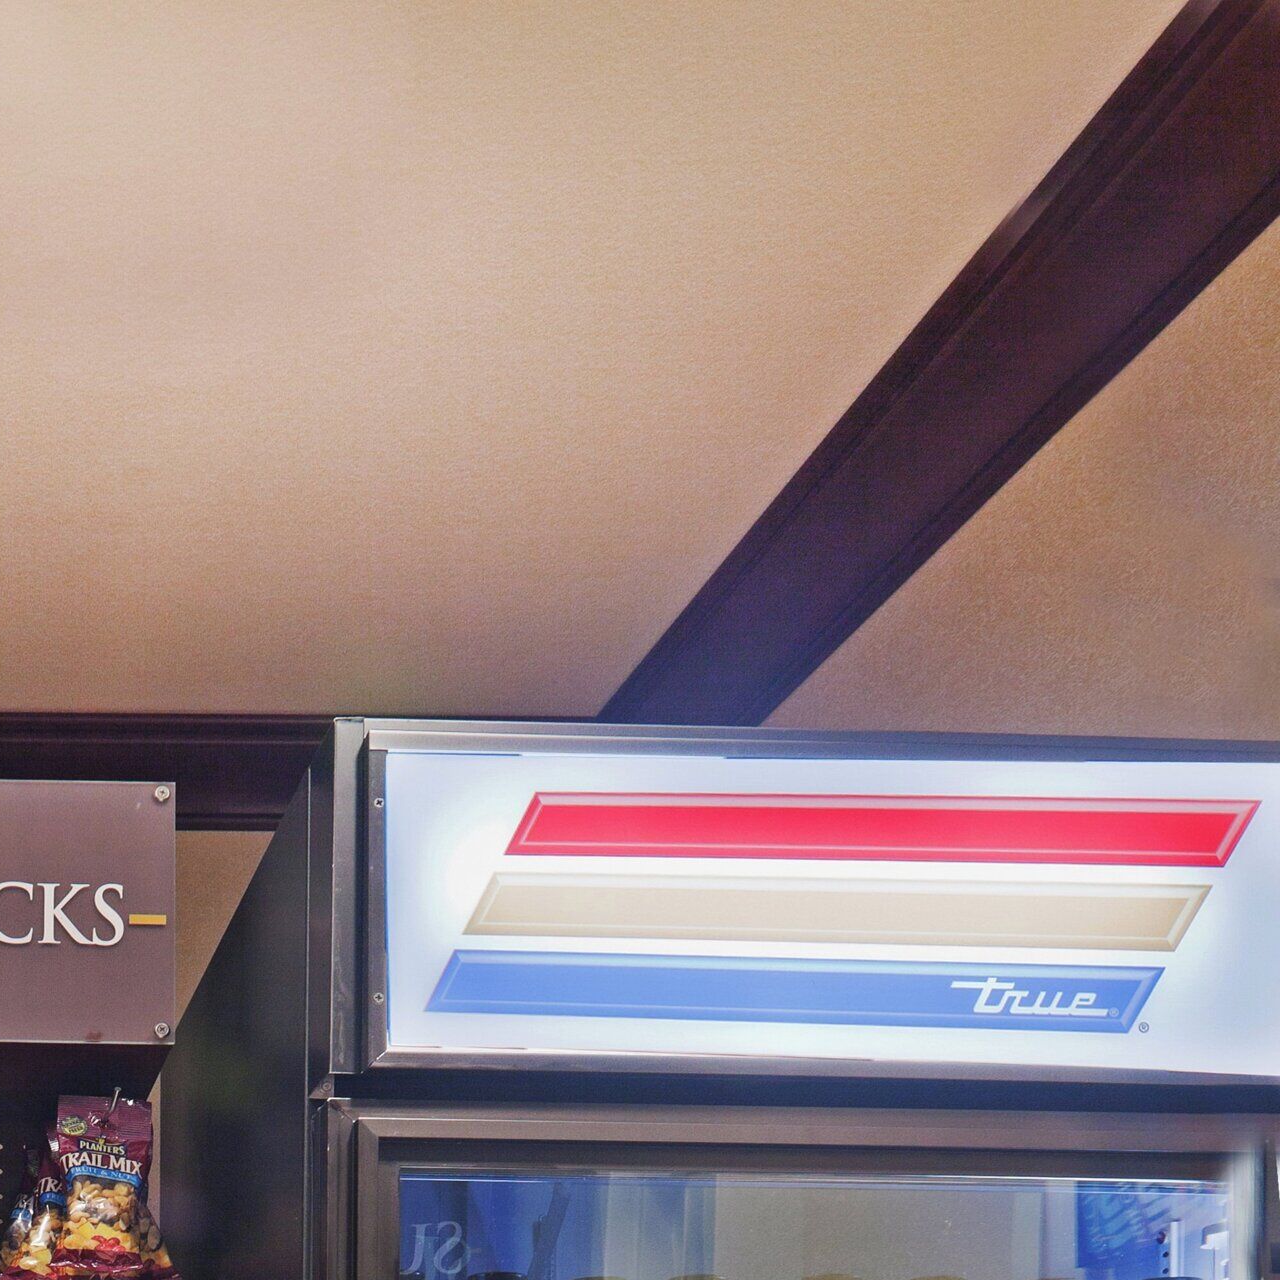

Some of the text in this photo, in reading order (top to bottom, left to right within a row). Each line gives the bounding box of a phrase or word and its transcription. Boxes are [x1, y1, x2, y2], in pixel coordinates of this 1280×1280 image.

[950, 977, 1108, 1017] true
[79, 1141, 125, 1155] PLANTERS
[60, 1154, 143, 1180] TRAIL MIX
